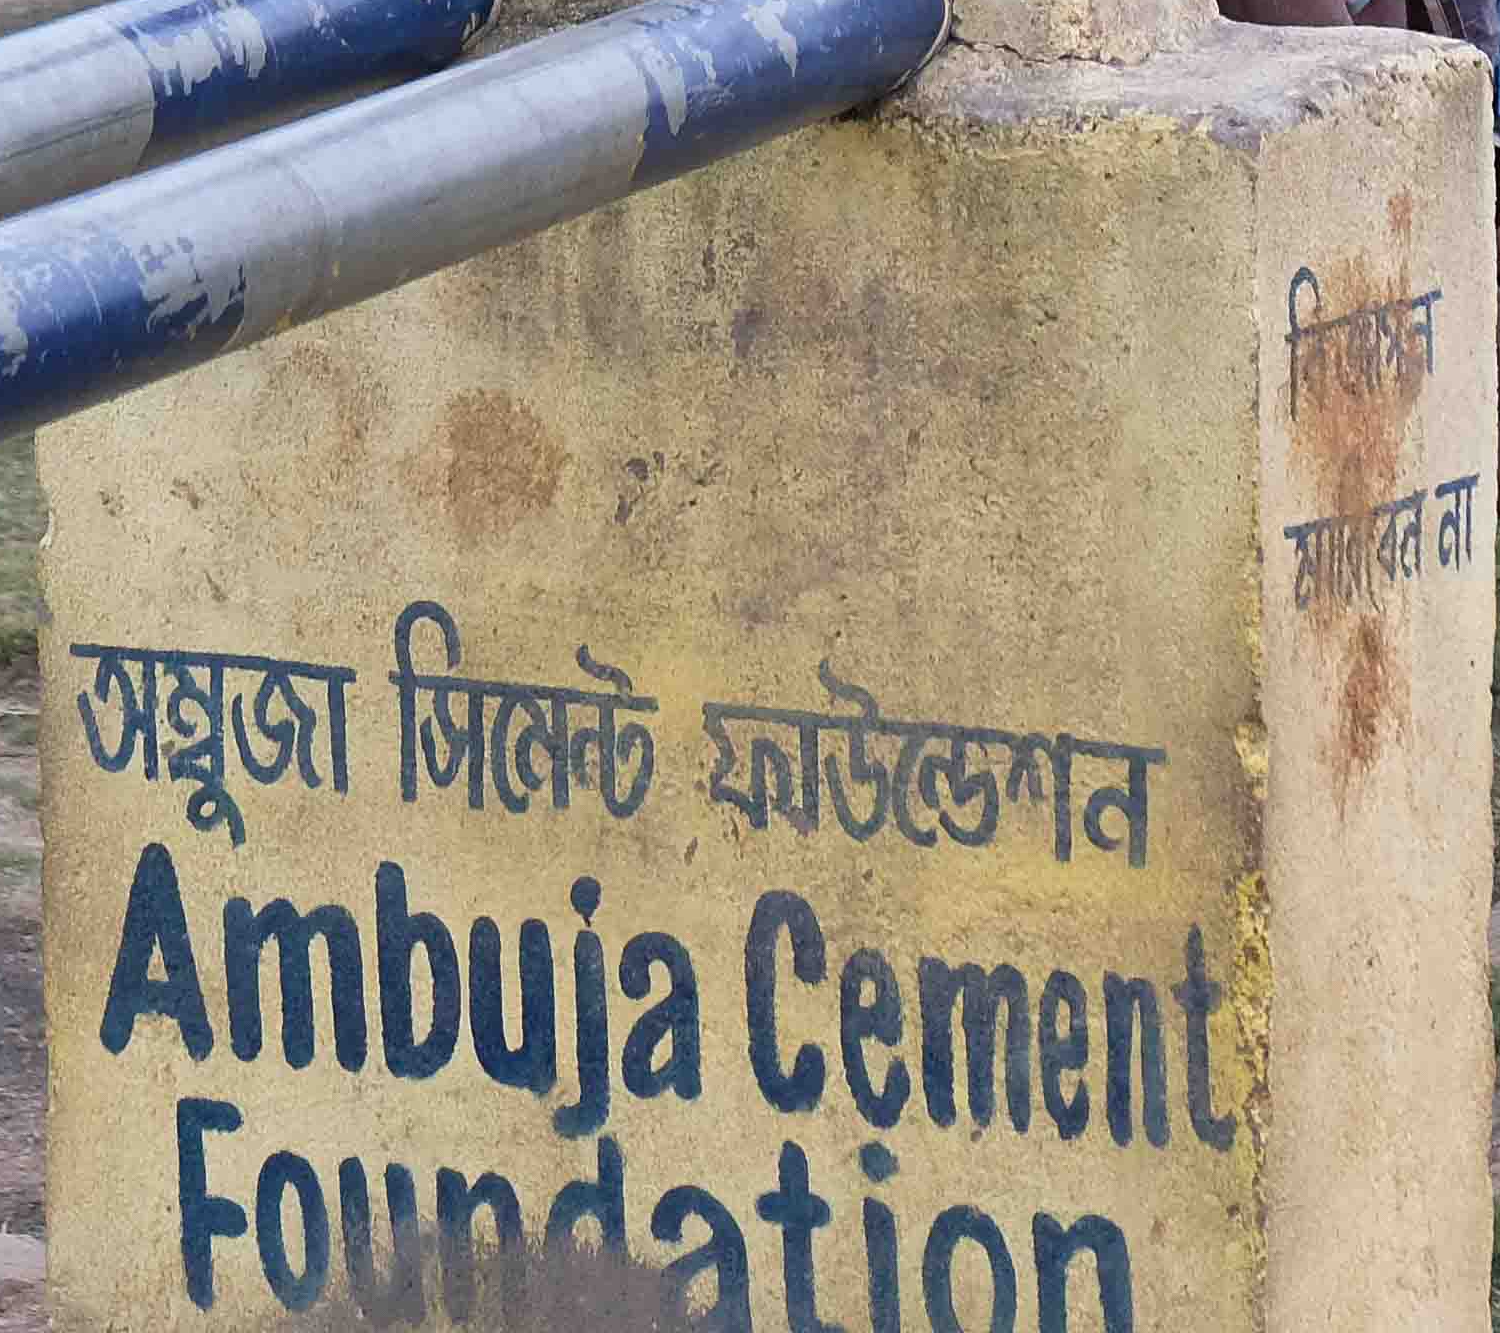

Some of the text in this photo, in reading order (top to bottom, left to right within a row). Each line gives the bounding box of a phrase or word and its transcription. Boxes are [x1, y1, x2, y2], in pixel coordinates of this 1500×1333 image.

[69, 599, 1168, 869] অম্বুজা সিমেন্ট ফাউন্ডেশন
[100, 841, 1238, 1151] Ambuja Cement
